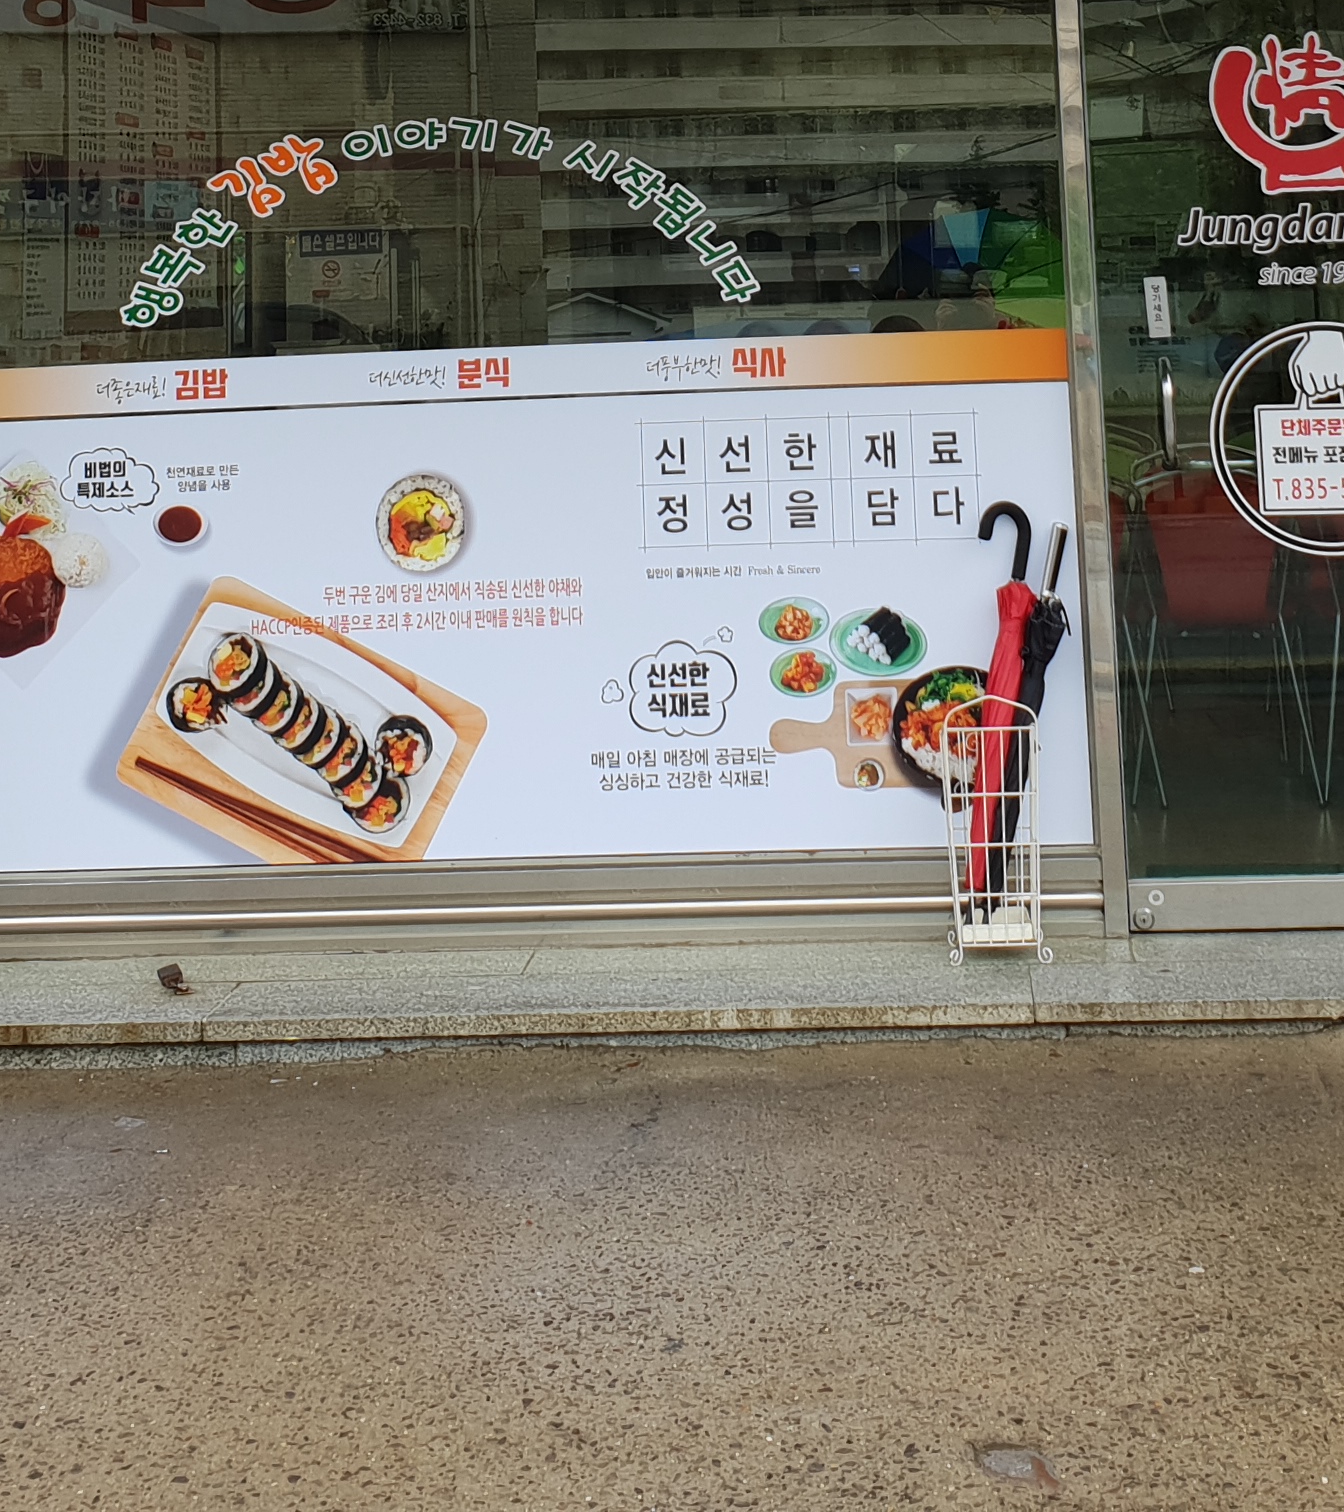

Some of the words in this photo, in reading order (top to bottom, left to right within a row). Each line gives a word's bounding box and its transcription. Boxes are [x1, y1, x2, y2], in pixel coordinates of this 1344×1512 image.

[121, 207, 238, 329] 행복한
[207, 133, 339, 218] 김밥
[342, 116, 553, 161] 이야기가
[563, 140, 760, 303] 시작됩니다
[1258, 262, 1316, 285] since
[457, 357, 510, 389] 분식
[732, 346, 786, 378] 식사
[175, 368, 228, 401] 김밥
[655, 432, 817, 476] 신선한
[864, 430, 963, 470] 재료
[1272, 445, 1318, 464] 전메뉴
[84, 461, 126, 479] 비법의
[166, 465, 216, 479] 천연재료로
[219, 464, 240, 477] 만든
[77, 480, 134, 499] 특제소스
[178, 480, 208, 493] 양념을
[211, 479, 232, 492] 사용
[657, 490, 819, 534] 정성을
[866, 486, 965, 527] 담다
[724, 565, 742, 578] 시간
[322, 585, 346, 606] 두번
[348, 584, 372, 605] 구운
[375, 583, 398, 604] 김에
[400, 582, 423, 604] 당일
[425, 580, 471, 603] 산지에서
[474, 579, 508, 601] 직송된
[511, 578, 545, 599] 신선한
[548, 577, 583, 598] 야채와
[328, 612, 373, 634] 제품으로
[375, 611, 399, 632] 조리
[401, 611, 413, 632] 후
[416, 610, 446, 631] 2시간
[449, 609, 472, 630] 이내
[474, 608, 509, 629] 판매를
[512, 607, 547, 628] 원칙을
[549, 606, 584, 627] 합니다
[646, 661, 710, 688] 신선한
[647, 691, 711, 719] 식재료
[590, 750, 621, 769] 매일
[627, 749, 657, 768] 아침
[663, 747, 710, 767] 매장에
[714, 746, 777, 766] 공급되는
[599, 772, 661, 792] 싱싱하고
[666, 770, 712, 790] 건강한
[718, 769, 770, 788] 식재료!
